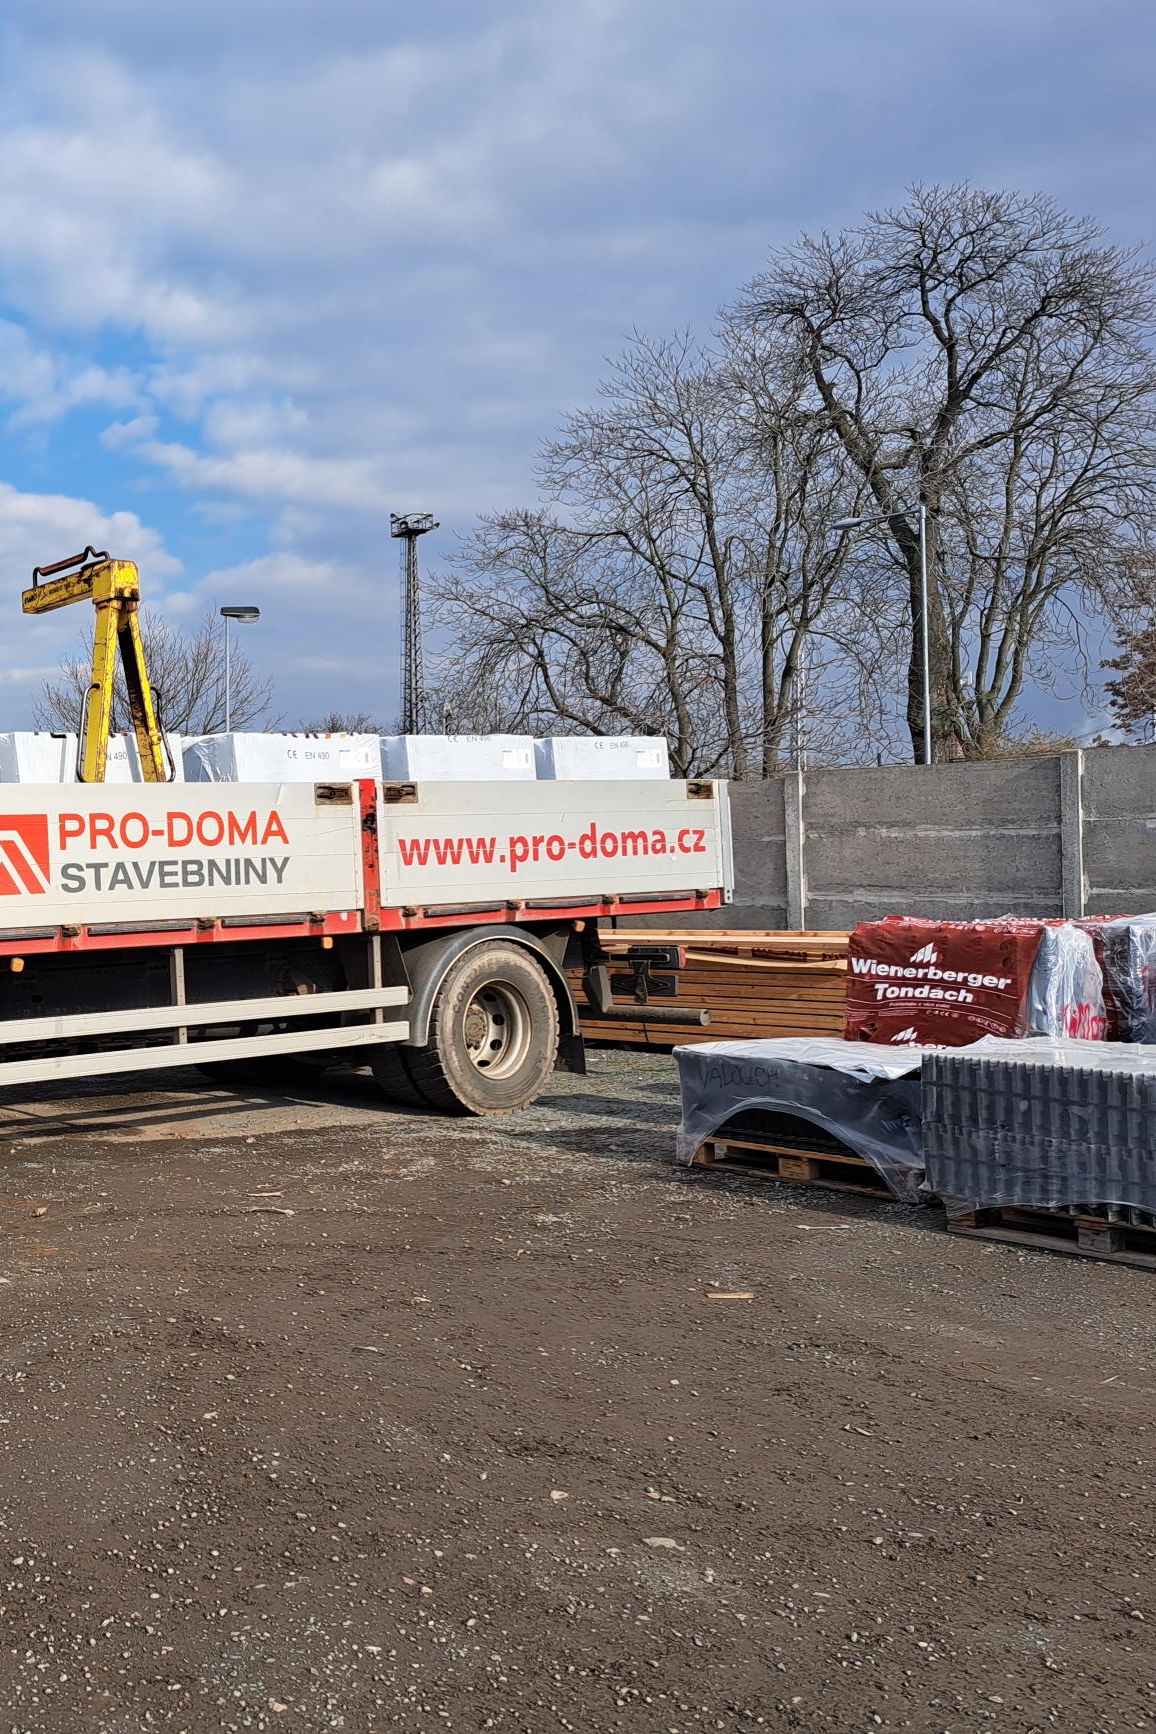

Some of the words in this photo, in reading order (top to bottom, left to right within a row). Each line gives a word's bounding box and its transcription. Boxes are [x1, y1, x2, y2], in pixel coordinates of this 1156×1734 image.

[113, 751, 128, 760] 490
[305, 751, 316, 760] EN
[317, 751, 330, 760] 490
[58, 810, 290, 851] PRO-DOMA
[398, 822, 707, 873] www.pro-doma.cz
[60, 856, 291, 894] STAVEBNINY
[851, 957, 1012, 990] Wienerberger
